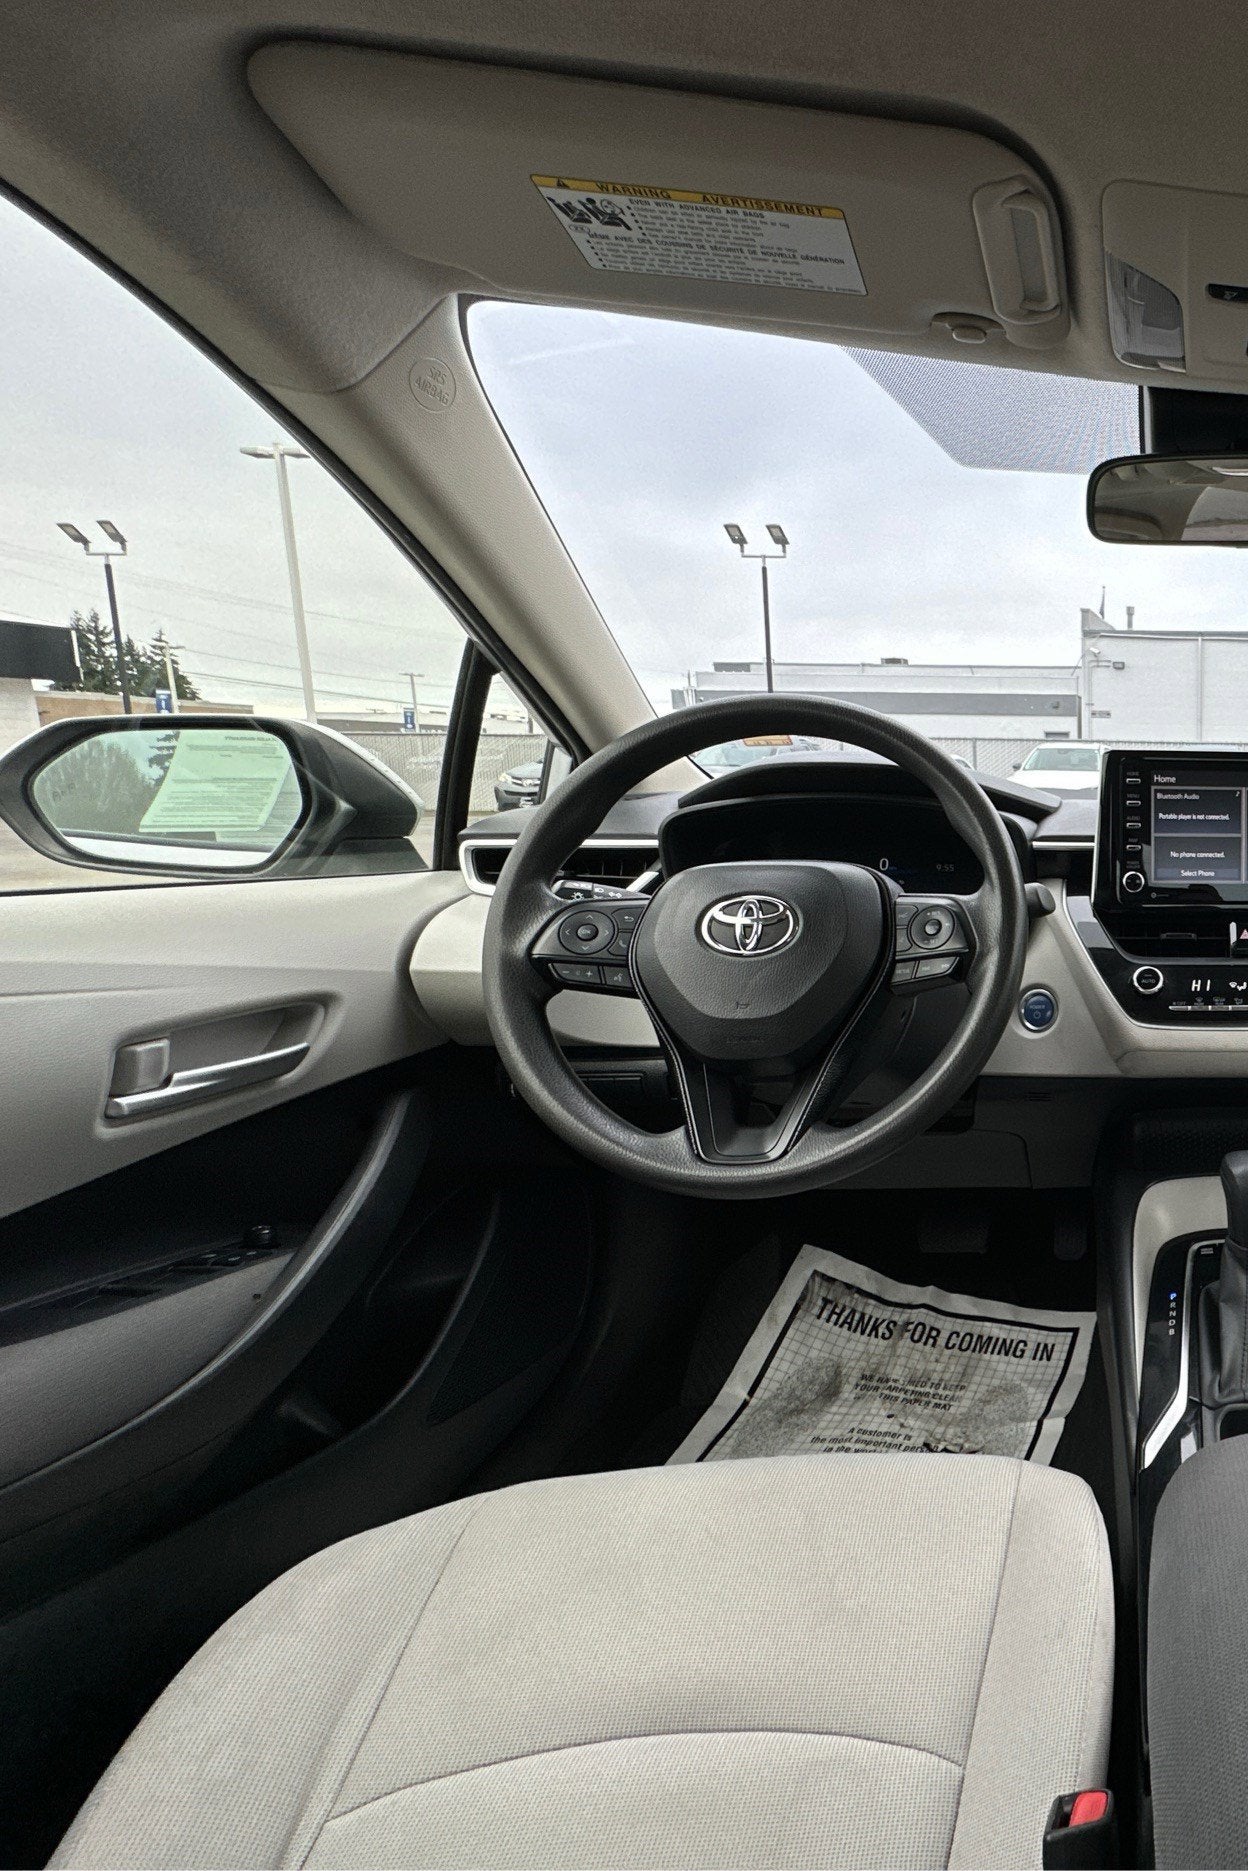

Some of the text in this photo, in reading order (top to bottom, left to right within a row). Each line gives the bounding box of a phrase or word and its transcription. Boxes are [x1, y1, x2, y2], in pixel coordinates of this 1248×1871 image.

[595, 181, 823, 217] WARNING AVERTISSEMENT
[629, 198, 650, 207] EVEN
[654, 201, 675, 209] WITH
[679, 203, 722, 214] ADVANCED
[743, 210, 765, 219] BAGS
[615, 234, 634, 243] AVEC
[637, 237, 653, 245] DES
[656, 239, 693, 249] COUSSINS
[697, 243, 707, 251] DE
[748, 248, 758, 256] DE
[761, 250, 797, 260] NOUVELLE
[414, 376, 450, 405] AIRBAG
[1153, 774, 1176, 784] Home
[1156, 792, 1183, 800] Bluetooth
[1158, 812, 1178, 820] Portable
[1179, 813, 1192, 821] player
[1206, 813, 1231, 821] connected.
[1179, 851, 1196, 860] phone
[1197, 851, 1226, 859] connected.
[879, 857, 890, 871] 0
[936, 864, 955, 872] 9:55
[1181, 869, 1215, 877] Select Phone
[1191, 979, 1211, 992] HI
[815, 1297, 1056, 1362] THANKS FOR COMING IN
[1168, 1328, 1175, 1336] B
[860, 1373, 875, 1383] WE
[901, 1378, 929, 1389] RIED
[929, 1382, 942, 1390] TO
[942, 1383, 967, 1392] KEEP
[854, 1382, 880, 1393] YOUR
[882, 1384, 932, 1399] ARPETING
[878, 1392, 900, 1403] THIS
[900, 1397, 931, 1407] PAPER
[932, 1402, 953, 1411] MAT
[856, 1428, 902, 1440] customer
[903, 1433, 912, 1441] is
[810, 1435, 939, 1452] the most important persn
[834, 1445, 852, 1453] the
